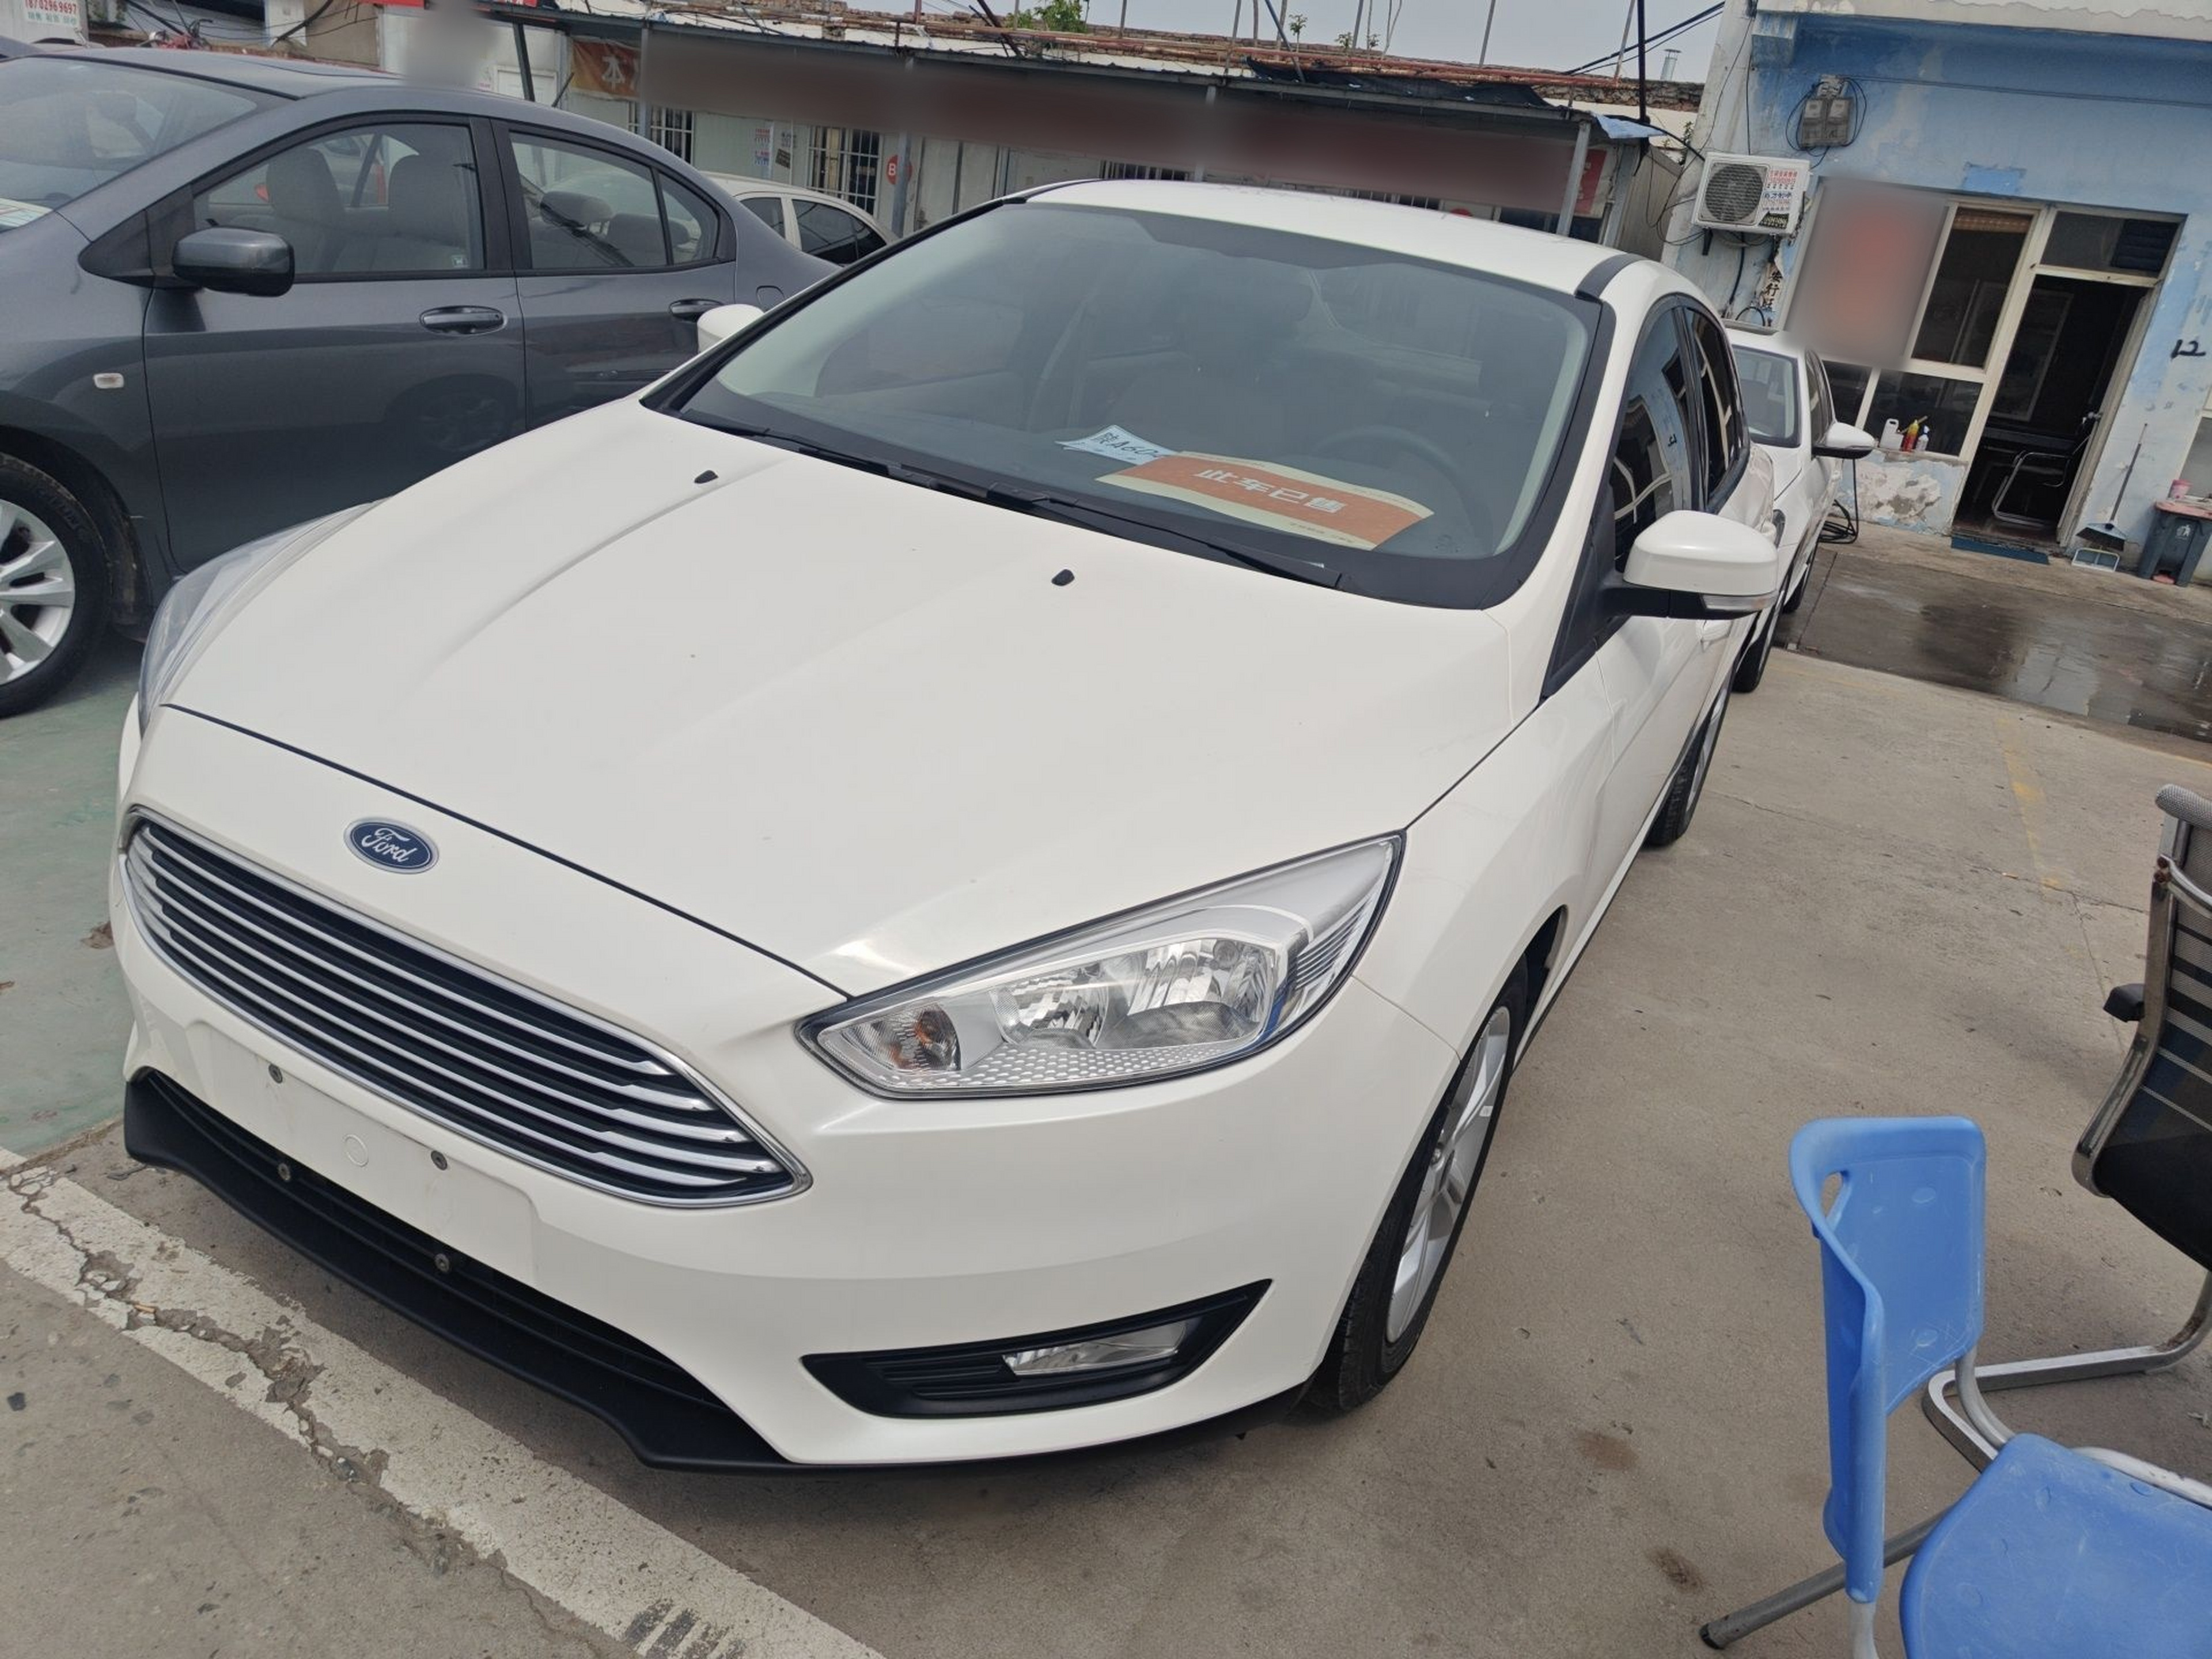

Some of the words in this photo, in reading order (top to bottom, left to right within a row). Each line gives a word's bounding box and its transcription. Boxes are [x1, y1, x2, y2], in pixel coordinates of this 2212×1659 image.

[1190, 469, 1349, 514] 此车已售
[361, 828, 418, 862] Ford
